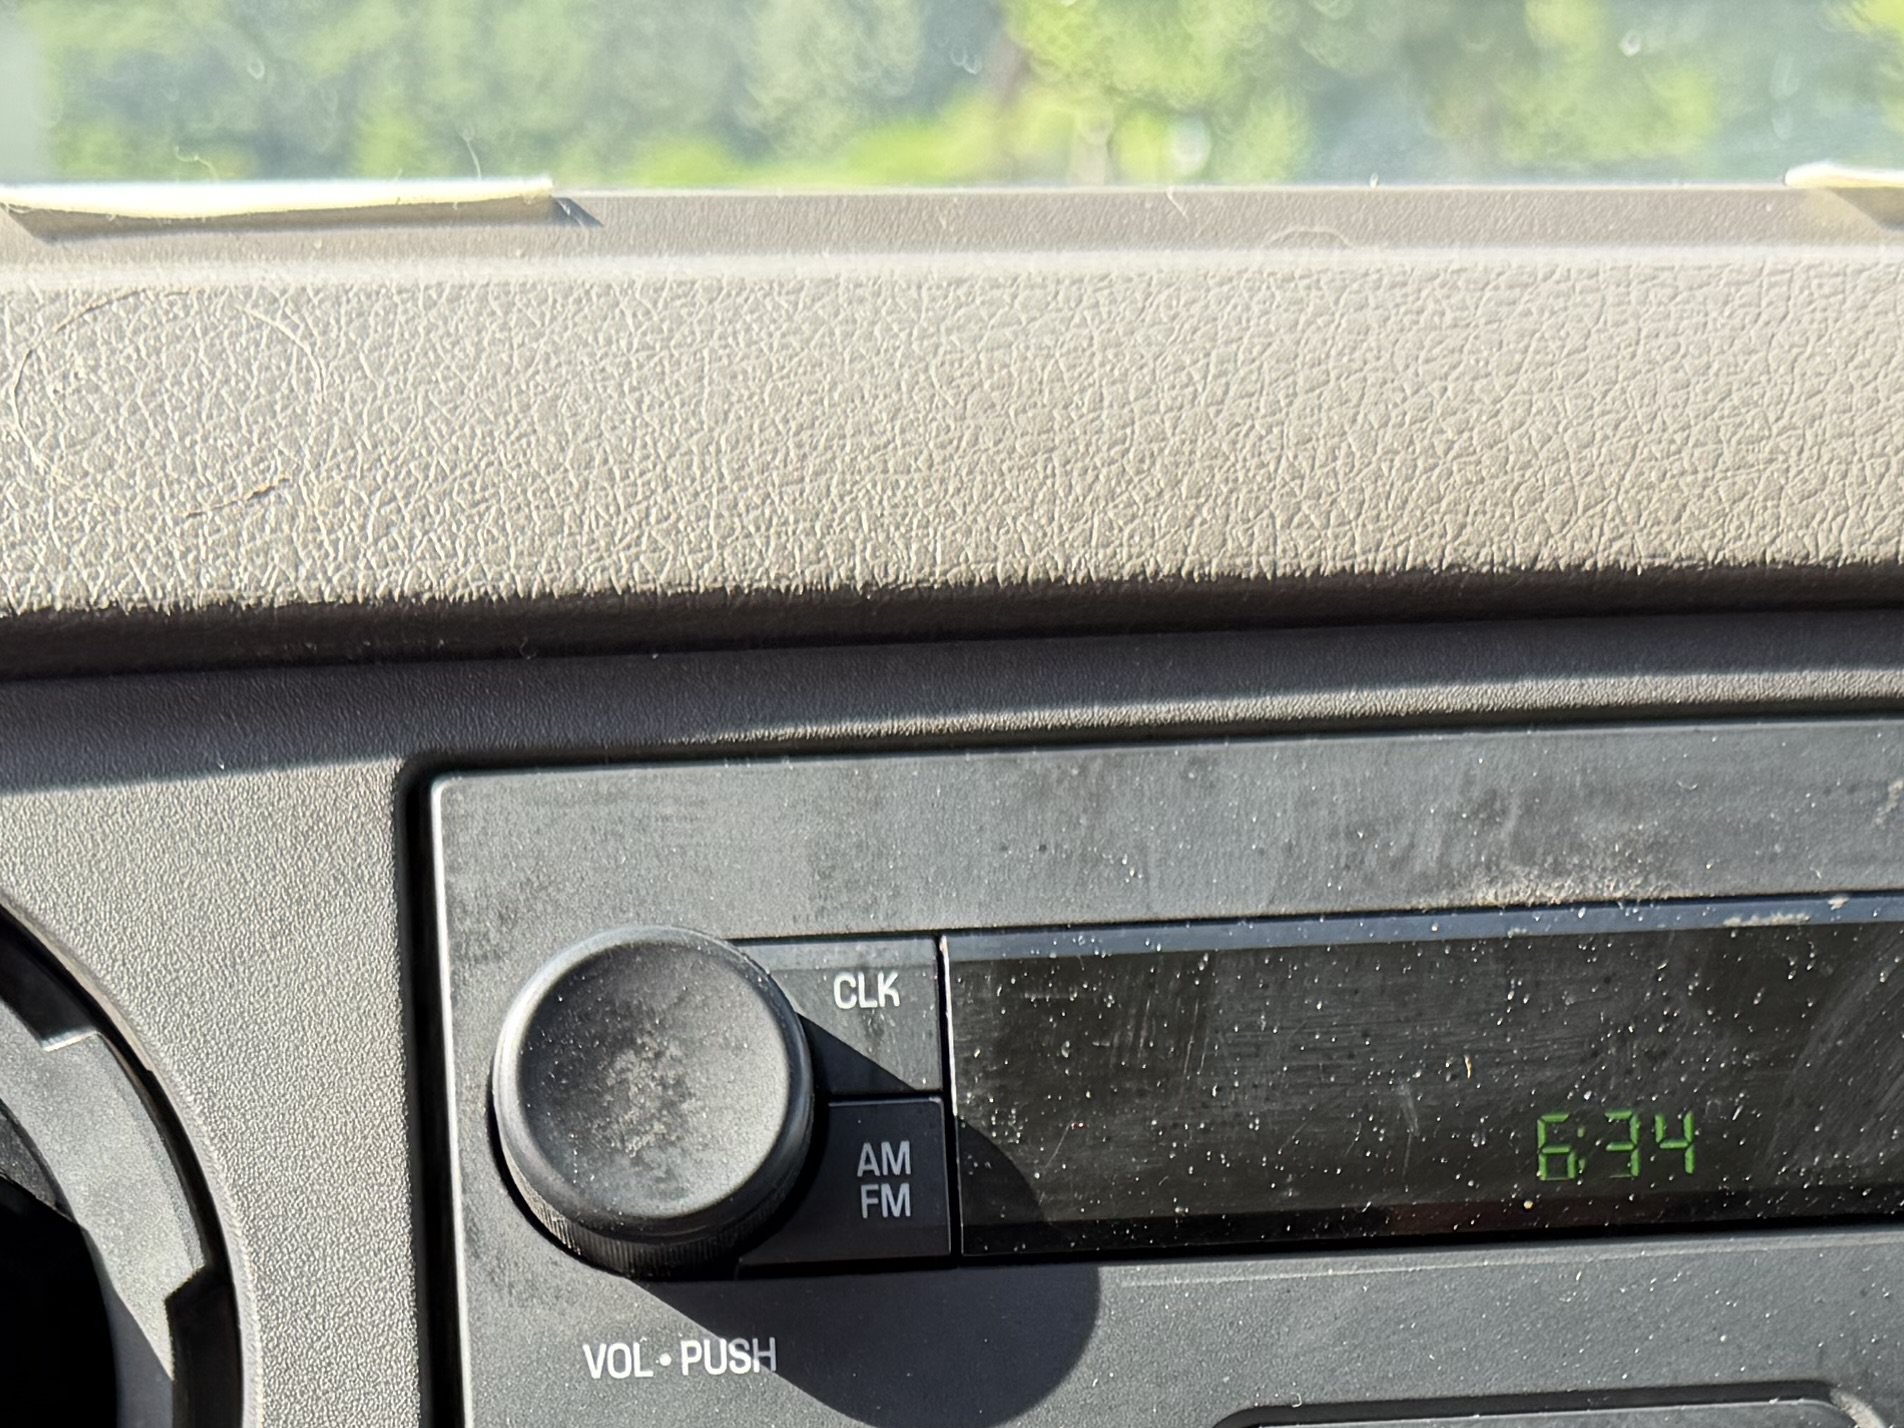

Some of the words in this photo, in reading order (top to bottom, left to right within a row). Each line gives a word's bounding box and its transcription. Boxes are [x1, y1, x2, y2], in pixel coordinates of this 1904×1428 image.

[834, 972, 899, 1009] CLK
[858, 1141, 911, 1176] AM
[1537, 1109, 1696, 1179] 6:34
[861, 1183, 910, 1218] FM
